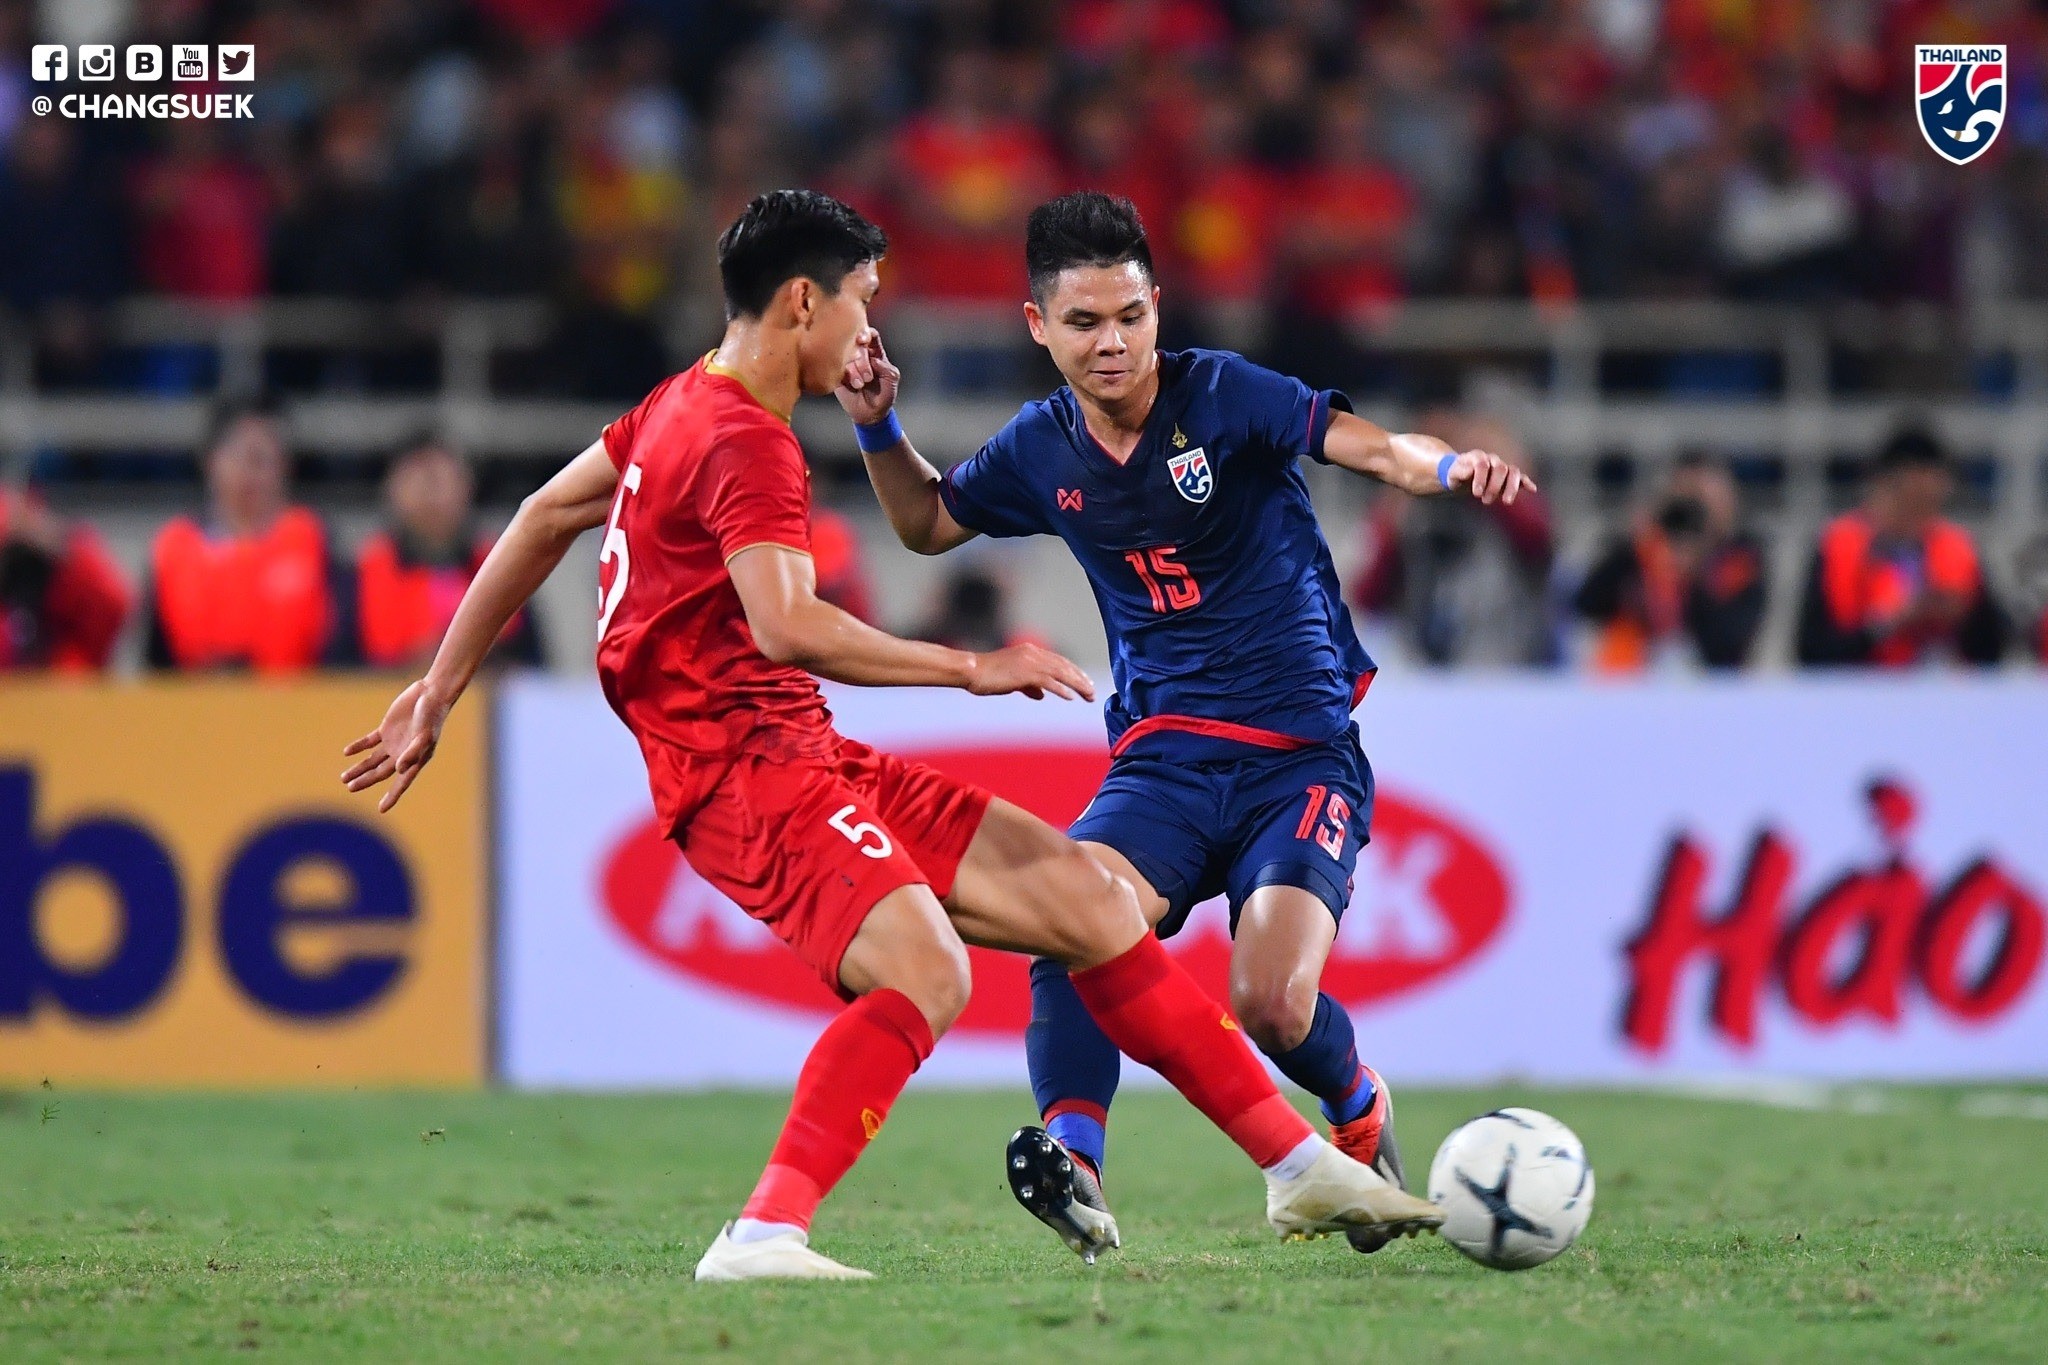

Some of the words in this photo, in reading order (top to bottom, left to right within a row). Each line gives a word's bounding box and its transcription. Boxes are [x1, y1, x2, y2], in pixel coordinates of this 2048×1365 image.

[1170, 450, 1202, 467] THAILAND
[1125, 547, 1201, 613] 15
[827, 804, 893, 859] 5
[1295, 785, 1351, 861] 15
